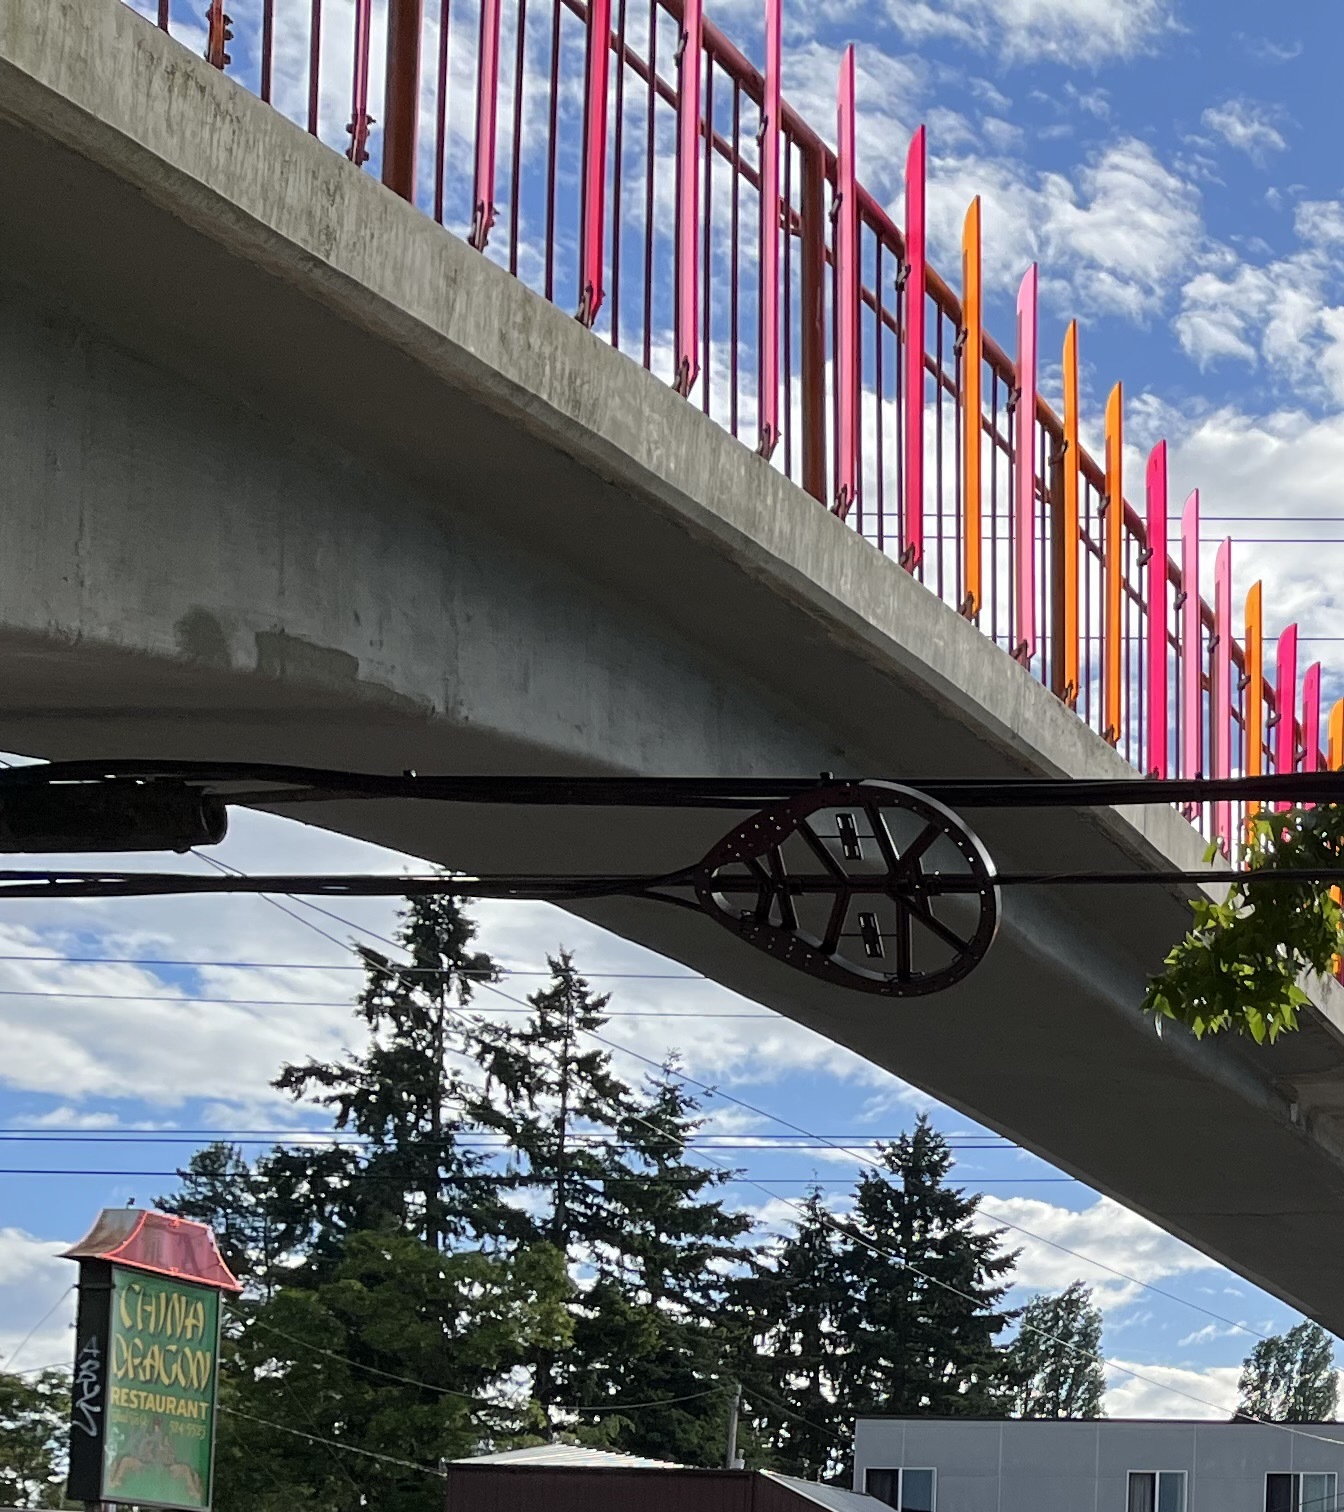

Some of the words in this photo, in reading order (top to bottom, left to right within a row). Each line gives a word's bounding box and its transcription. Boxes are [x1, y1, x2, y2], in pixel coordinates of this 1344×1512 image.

[120, 1283, 205, 1341] CHINA
[112, 1333, 211, 1392] DRAGON
[111, 1386, 209, 1420] RESTAURANT
